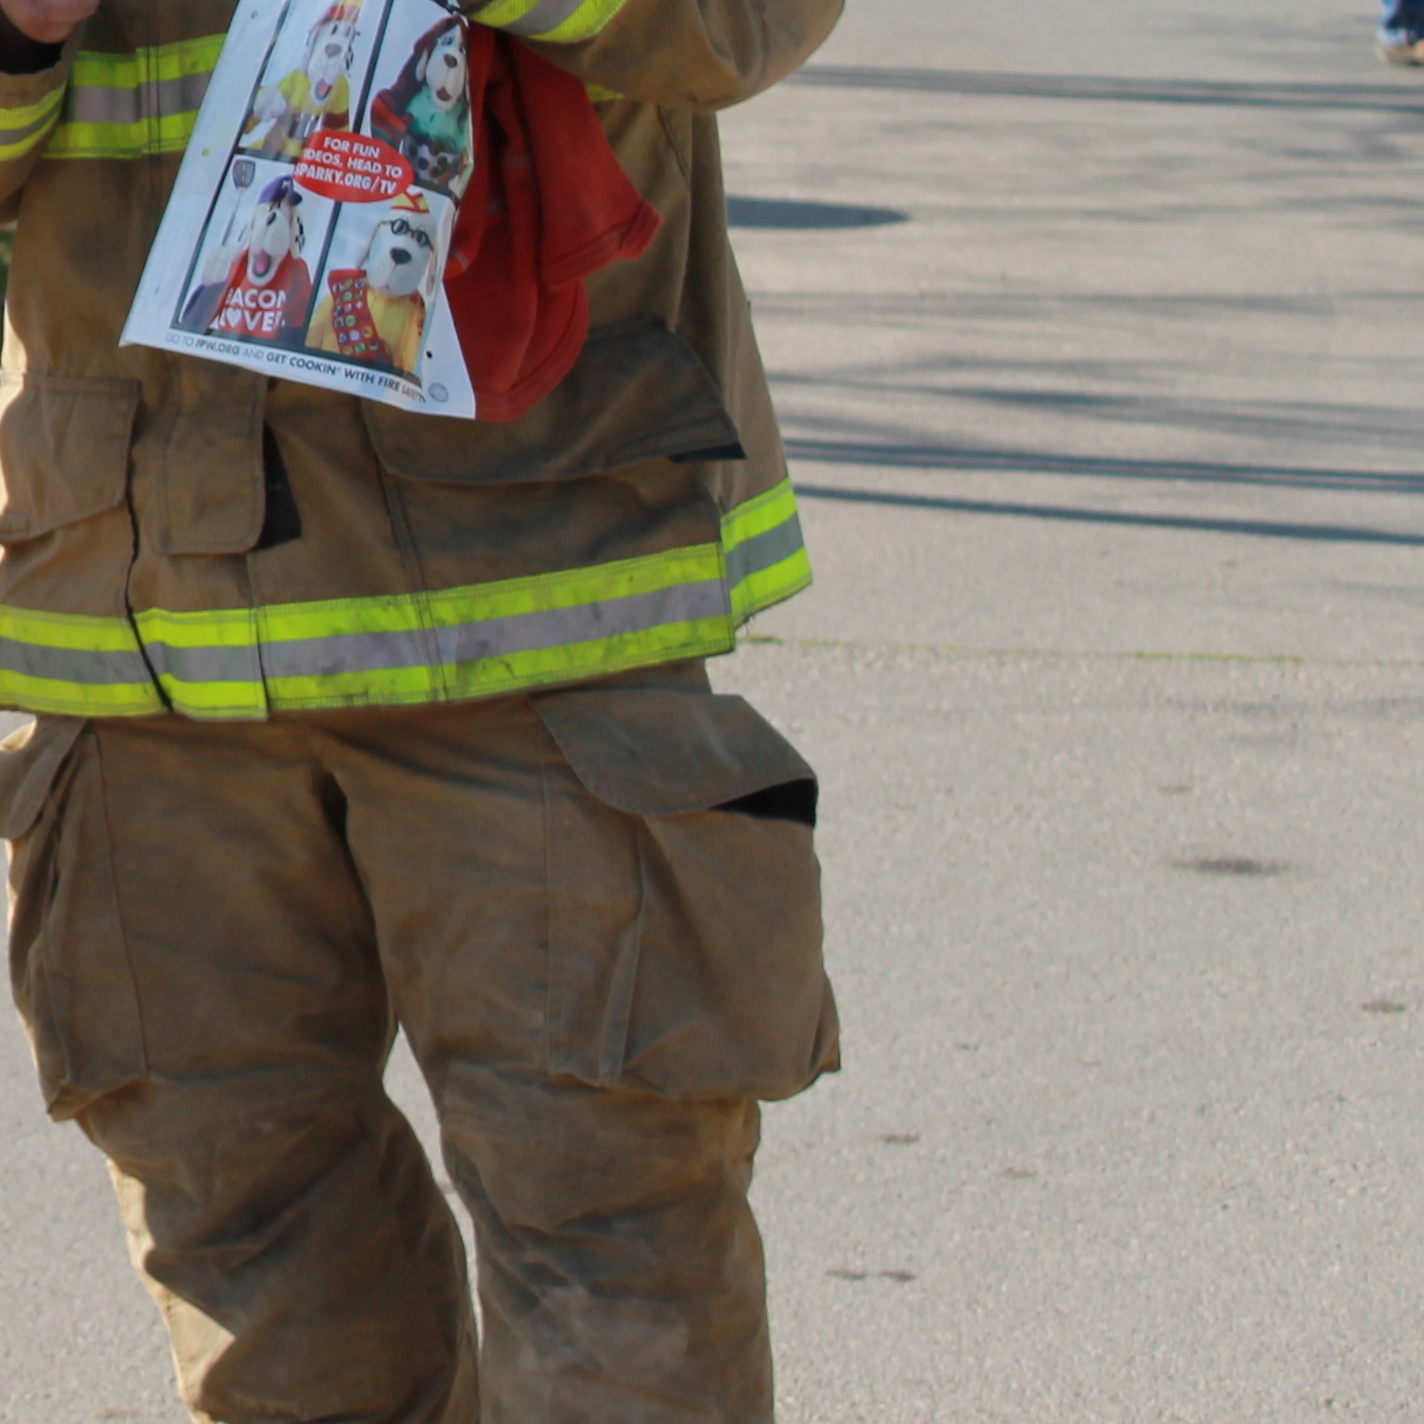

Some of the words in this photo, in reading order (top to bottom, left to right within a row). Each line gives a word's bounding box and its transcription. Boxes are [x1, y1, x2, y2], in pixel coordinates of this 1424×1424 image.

[302, 147, 344, 168] IDEOS,
[347, 157, 383, 175] HEAD
[385, 164, 404, 179] TO
[323, 136, 351, 153] FOR
[352, 142, 381, 159] FUN
[165, 332, 181, 345] GO
[182, 336, 194, 348] TO
[242, 346, 265, 360] AND
[266, 351, 288, 365] GET
[289, 356, 340, 376] COOKIN'
[343, 367, 375, 385] WITH
[377, 376, 401, 392] FIRE
